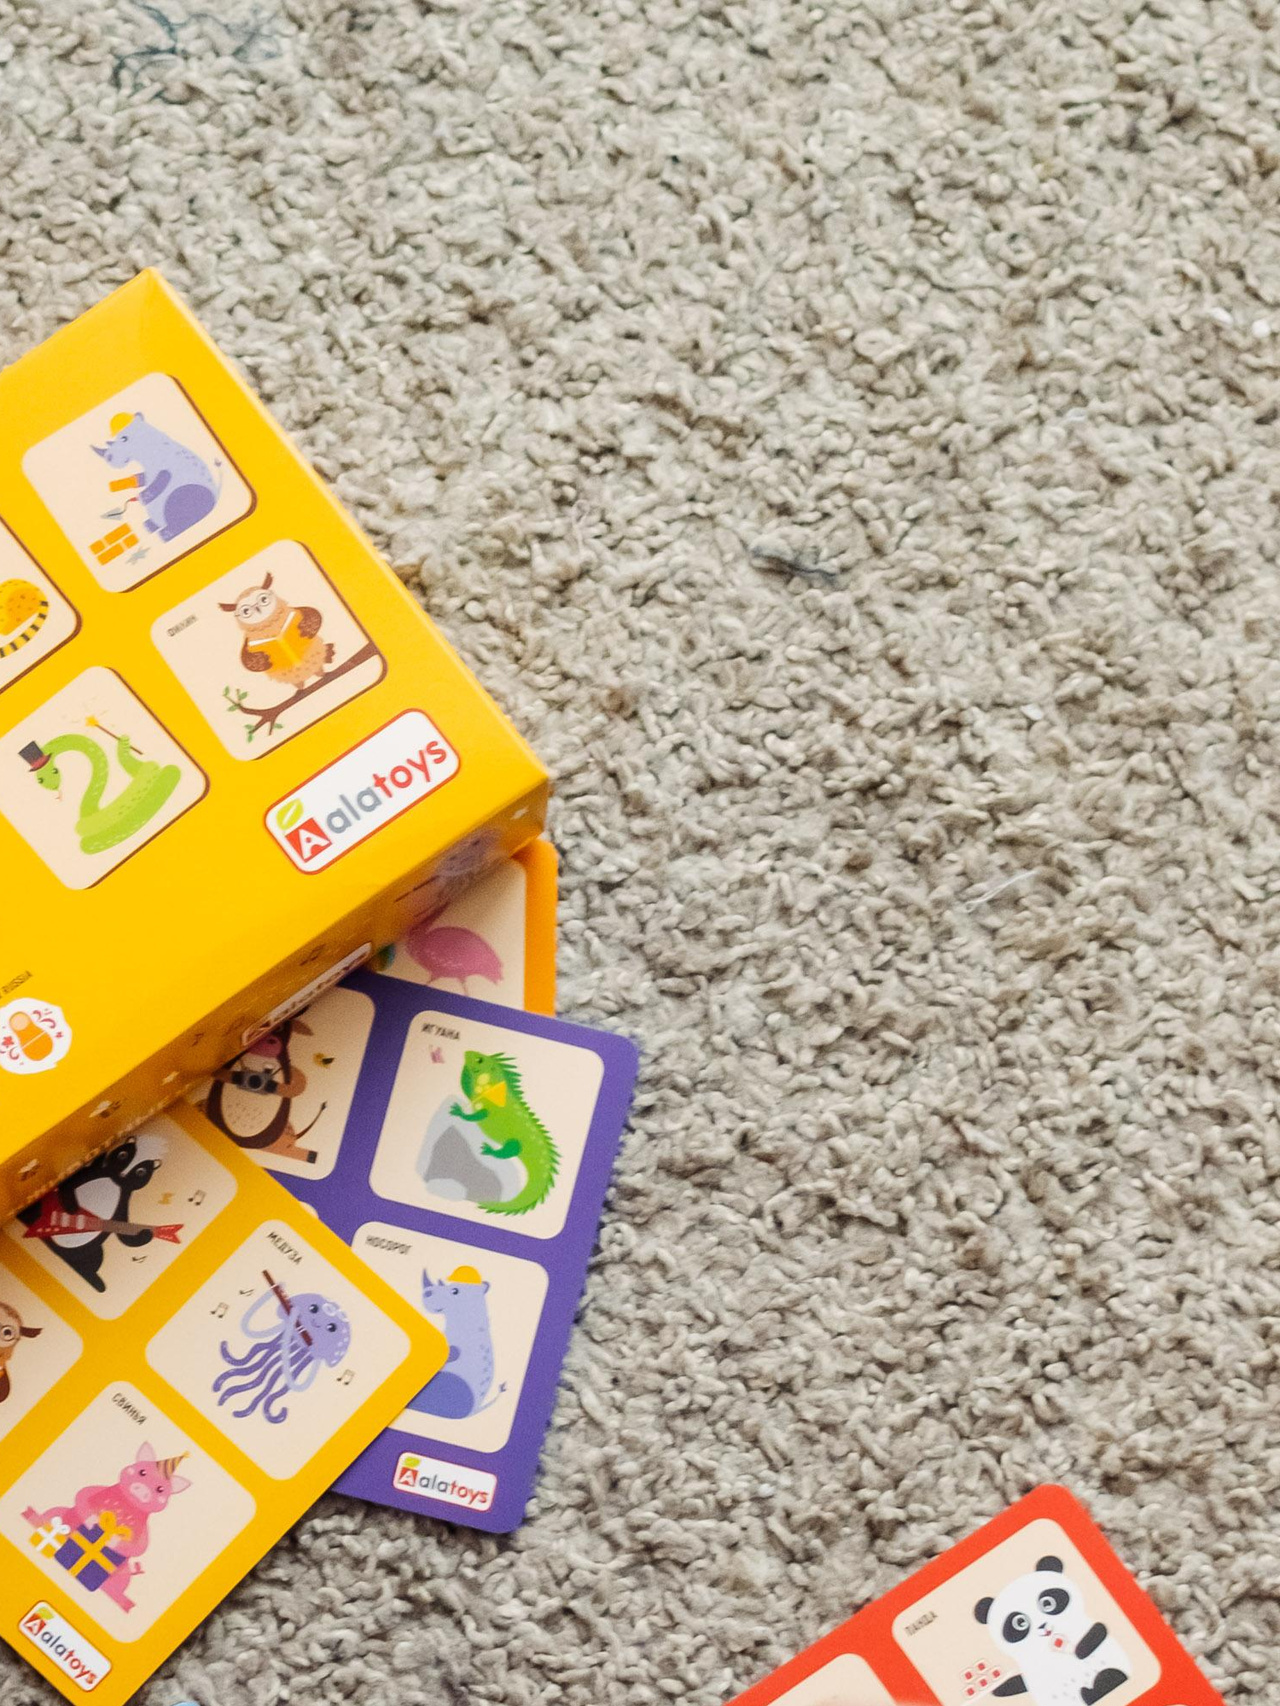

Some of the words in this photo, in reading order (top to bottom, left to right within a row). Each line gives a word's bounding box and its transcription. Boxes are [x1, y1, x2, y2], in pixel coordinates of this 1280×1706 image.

[2, 970, 34, 995] RUSSIA
[421, 1022, 460, 1040] ИГУАНА
[267, 1232, 302, 1265] МЕДУЗА
[367, 1237, 411, 1254] НОСОРОГ
[113, 1393, 146, 1424] СВИНЬЯ
